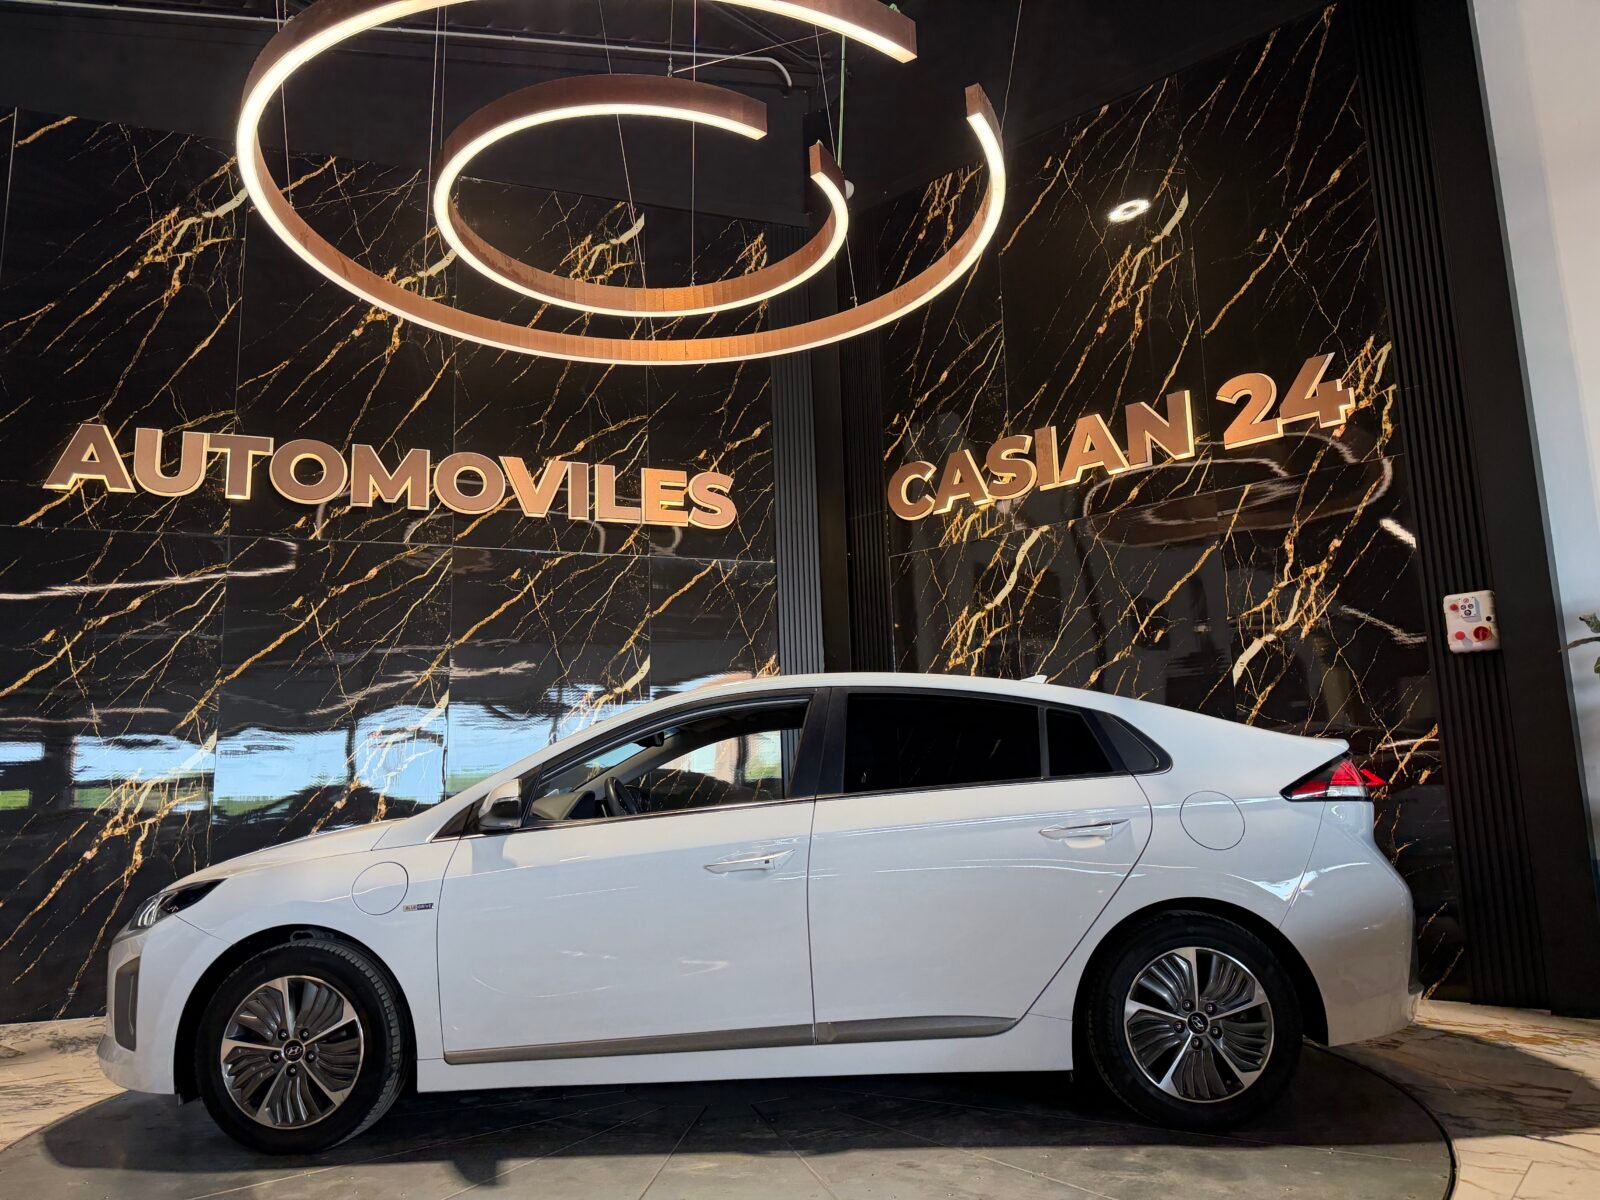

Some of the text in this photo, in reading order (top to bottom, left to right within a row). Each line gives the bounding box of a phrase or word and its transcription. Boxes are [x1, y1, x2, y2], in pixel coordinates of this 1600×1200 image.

[42, 423, 737, 530] AUTOMOVILES
[887, 352, 1356, 521] CASIAN 24
